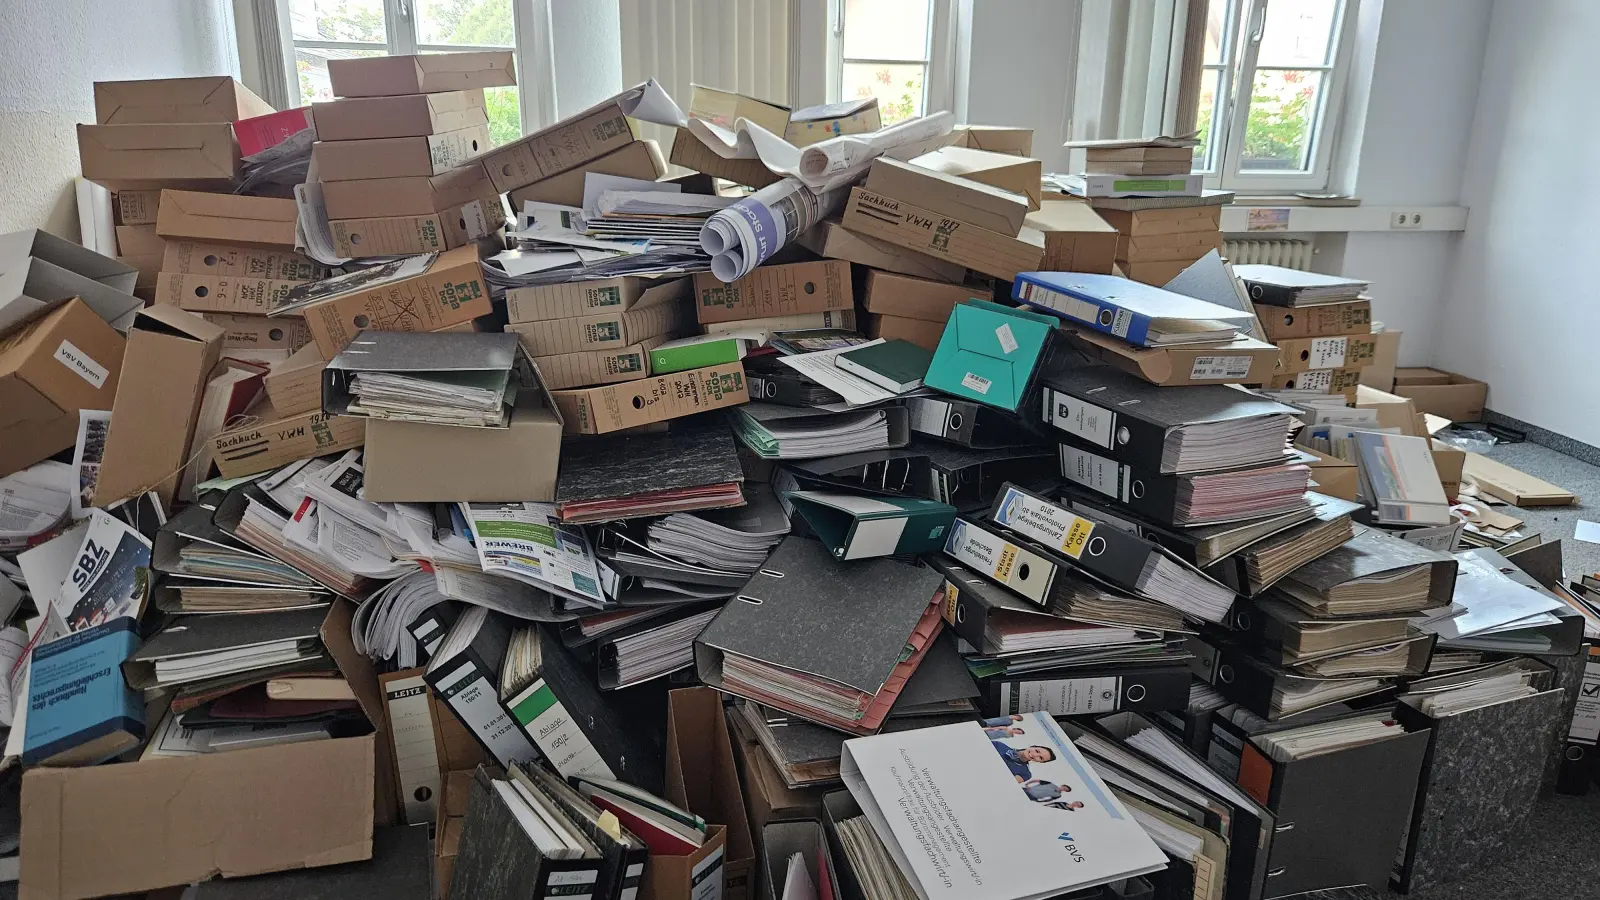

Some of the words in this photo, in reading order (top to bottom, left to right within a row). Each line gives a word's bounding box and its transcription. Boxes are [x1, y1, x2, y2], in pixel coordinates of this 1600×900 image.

[857, 191, 900, 211] Sachbuch
[906, 213, 933, 230] VWH
[421, 227, 429, 241] box
[426, 219, 439, 247] sona
[438, 291, 448, 306] box
[444, 282, 460, 310] sona
[61, 348, 78, 364] VSV
[75, 360, 100, 381] Bayern
[705, 379, 713, 396] box
[710, 371, 722, 401] sona
[216, 431, 262, 449] Sachbuch
[278, 427, 305, 441] VWH
[1064, 523, 1081, 548] Kasse
[1075, 532, 1086, 545] Ott
[485, 540, 534, 553] BREWER
[73, 538, 104, 589] SBZ
[997, 550, 1009, 573] Stadt
[48, 685, 87, 707] Handbuch
[394, 687, 421, 699] LEITZ
[460, 686, 479, 700] Ablage
[465, 691, 482, 705] 150/11
[32, 701, 46, 711] des
[539, 717, 562, 737] Ablage
[907, 778, 952, 852] Verwaltungsangestellte
[921, 767, 982, 865] Verwaltungsfachangestellte
[898, 796, 953, 889] Verwaltungsfachwirt/-in
[1063, 843, 1085, 864] BVS
[559, 885, 590, 895] LEITZ
